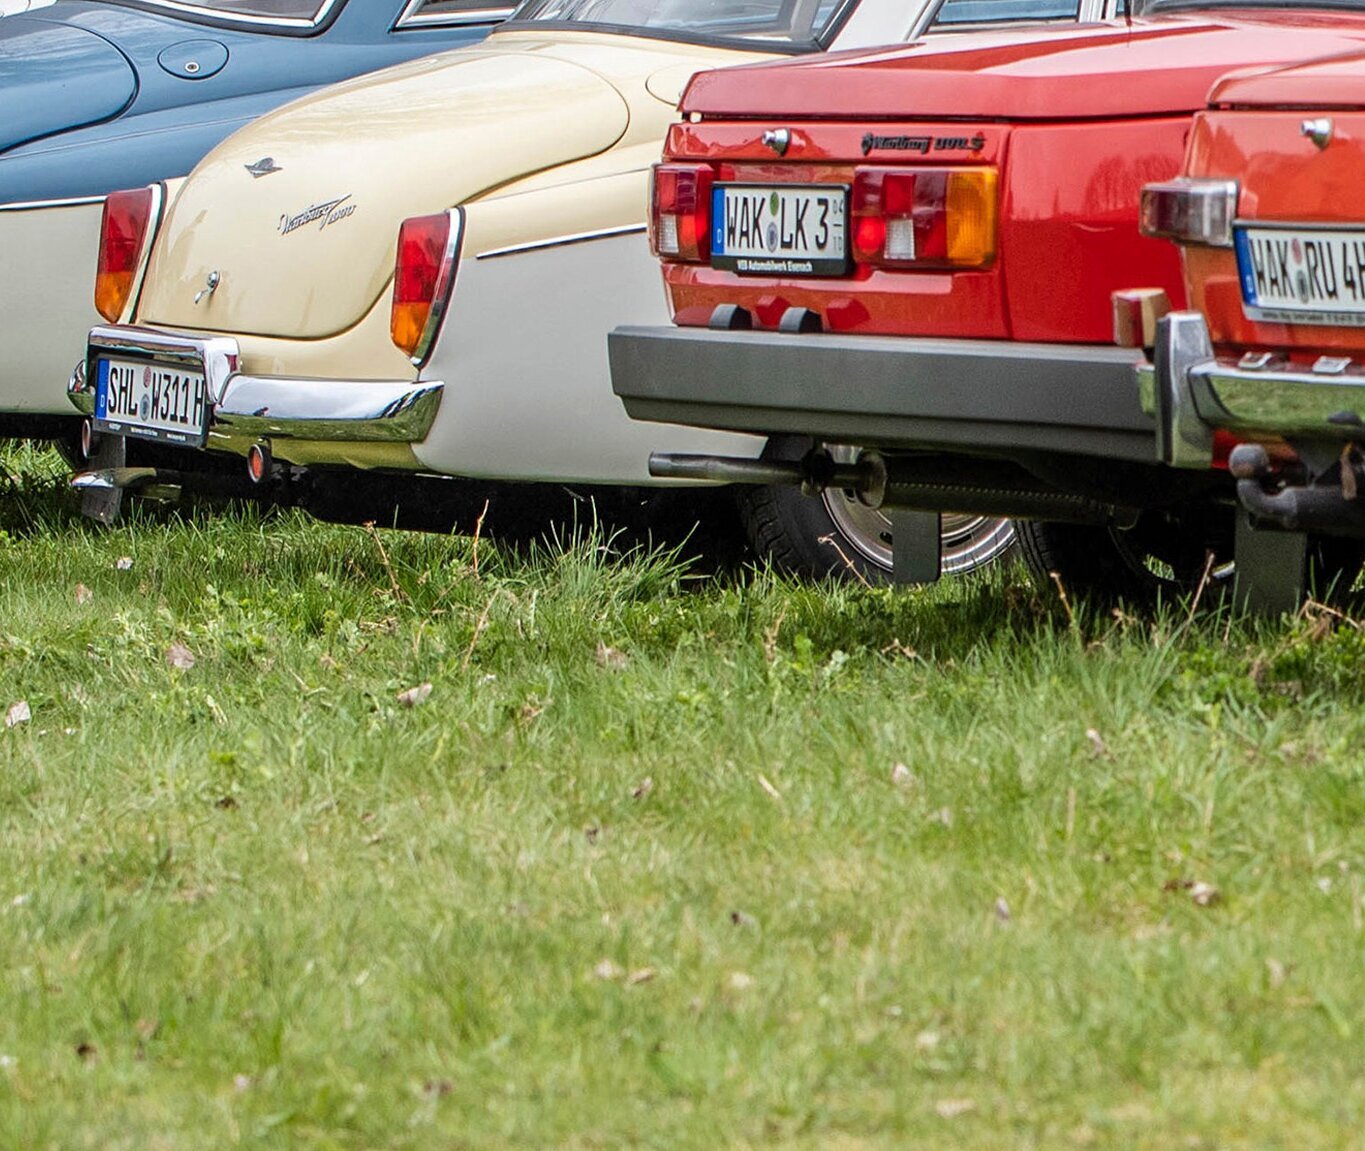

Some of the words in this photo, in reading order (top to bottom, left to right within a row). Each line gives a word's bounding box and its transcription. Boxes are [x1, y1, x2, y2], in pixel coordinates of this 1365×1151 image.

[726, 196, 765, 249] WAK
[781, 197, 809, 250] LK
[815, 198, 829, 250] 3
[1249, 238, 1295, 298] WAK
[1304, 241, 1338, 300] RU
[108, 367, 138, 416] SHL
